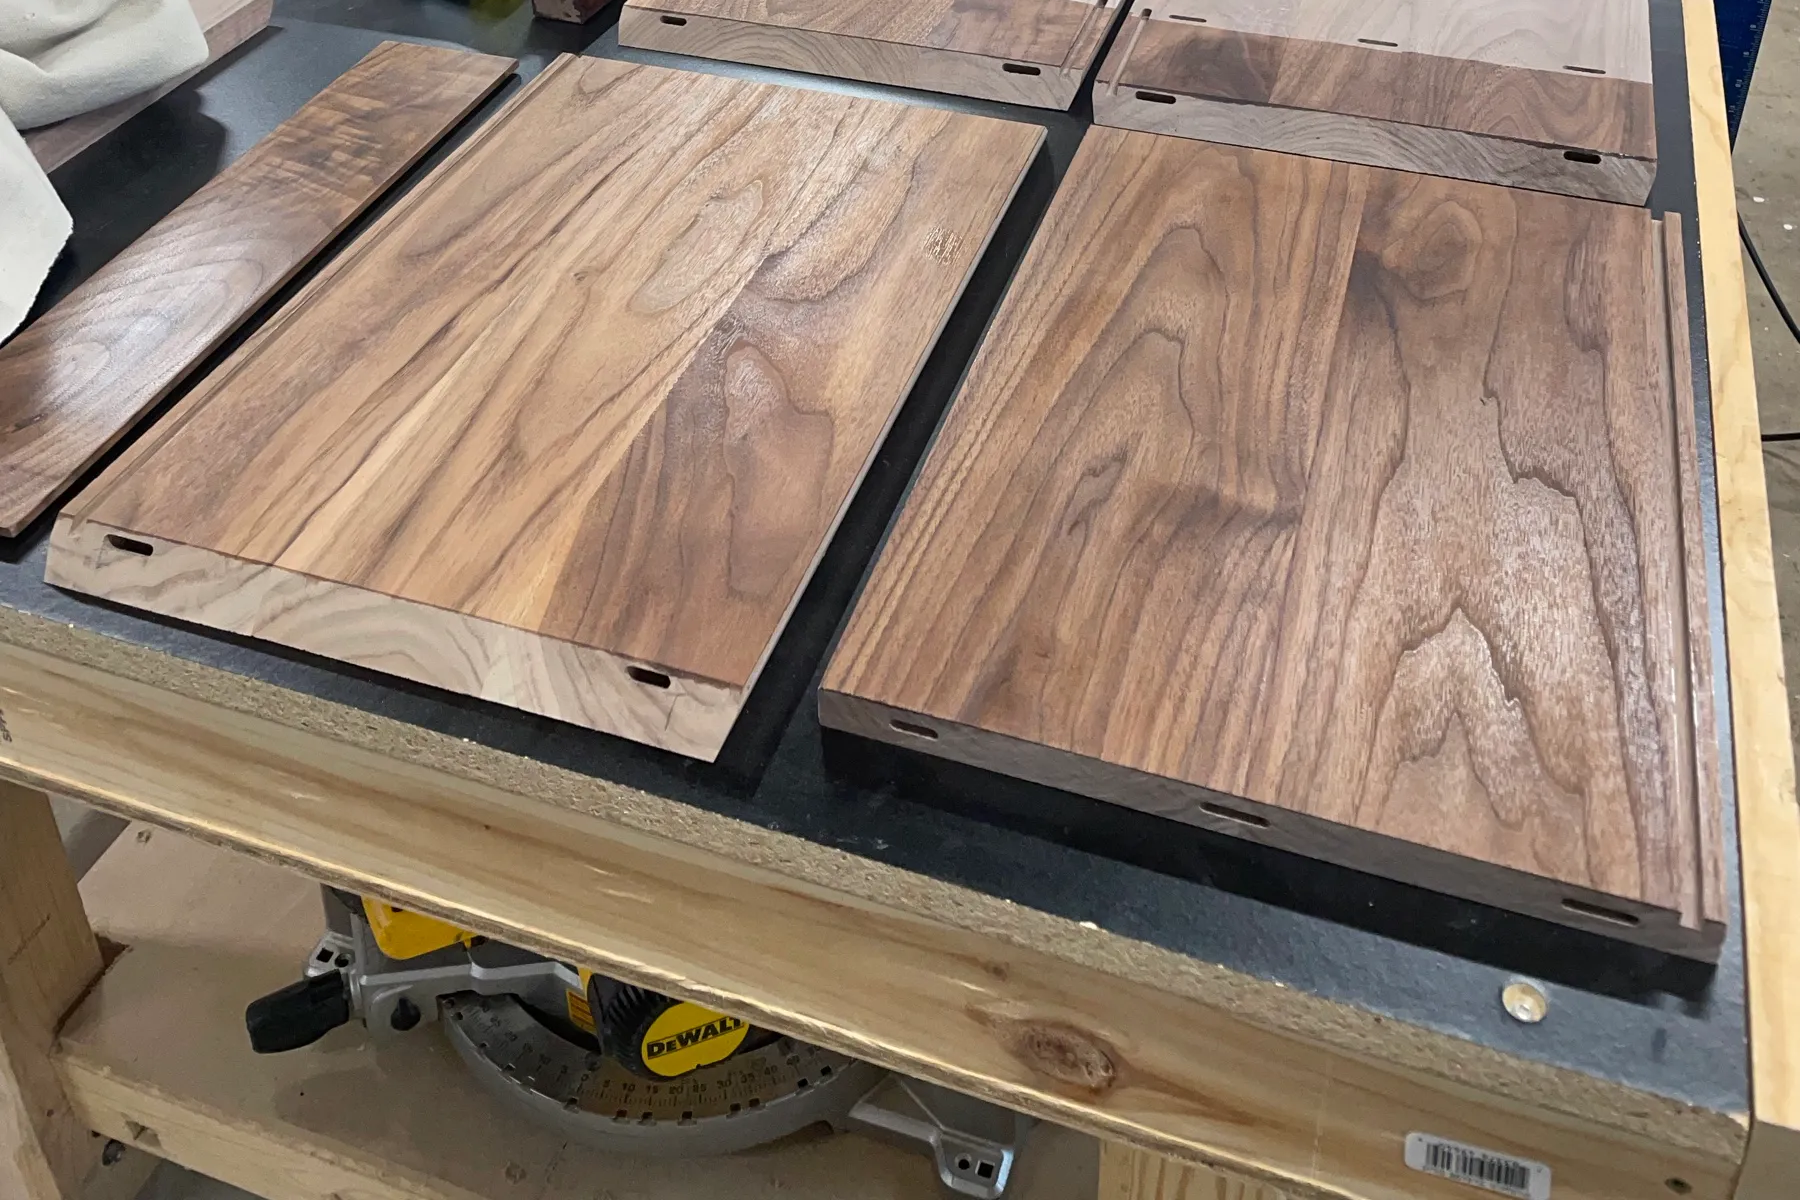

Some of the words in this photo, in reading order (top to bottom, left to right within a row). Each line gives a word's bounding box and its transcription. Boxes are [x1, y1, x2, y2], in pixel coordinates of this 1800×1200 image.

[622, 1082, 636, 1092] 10
[668, 1085, 683, 1095] 20
[716, 1079, 732, 1089] 30
